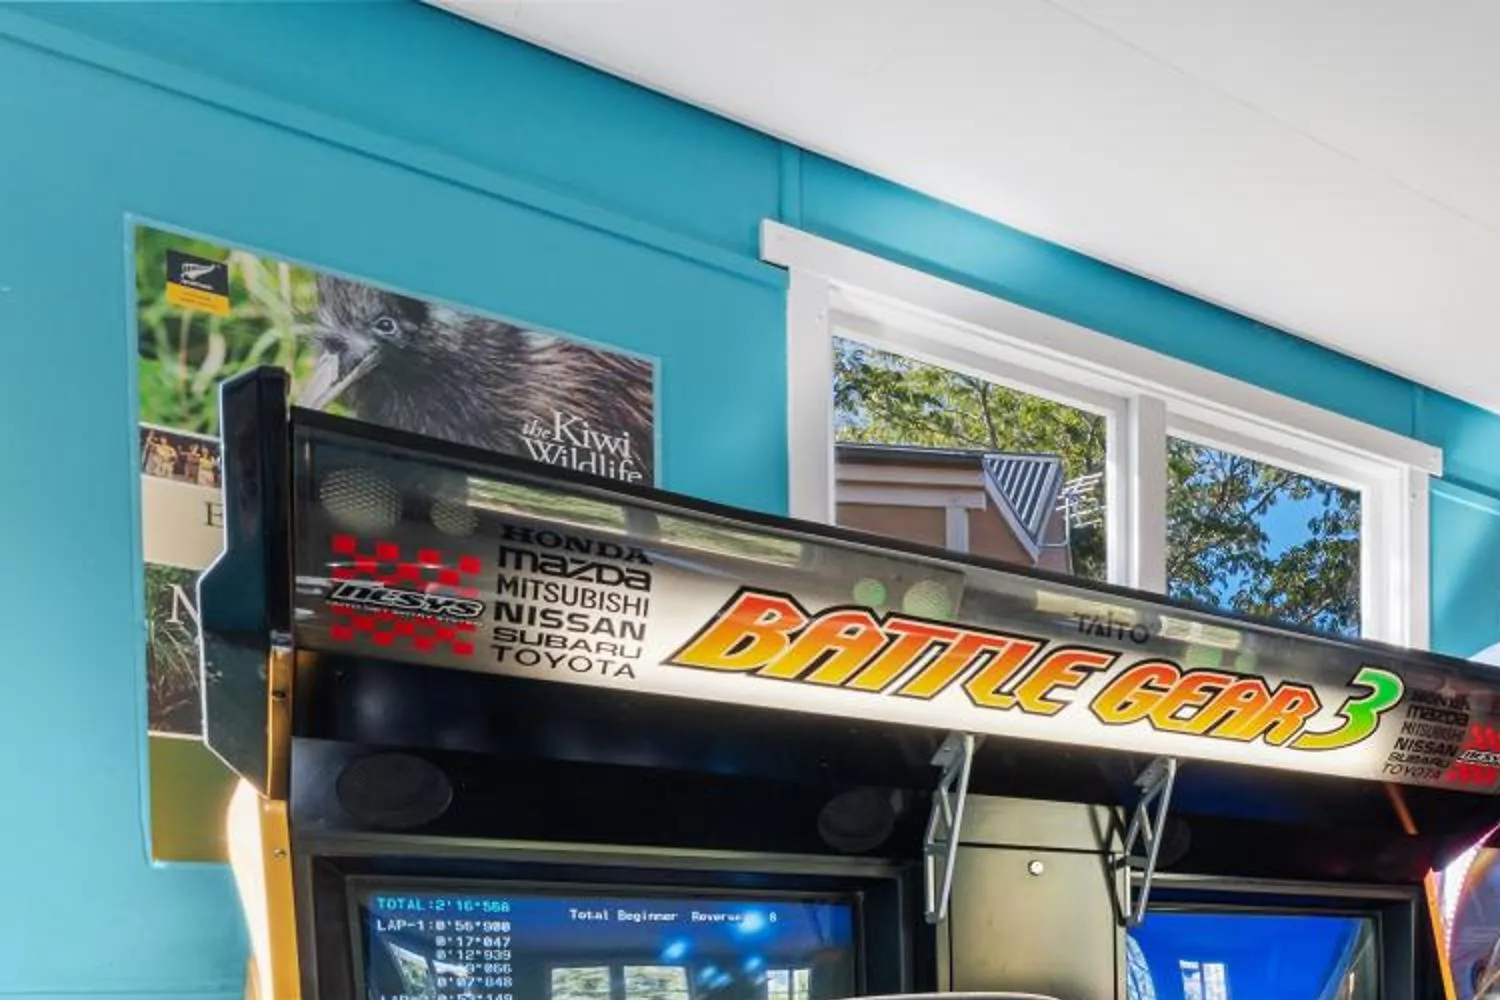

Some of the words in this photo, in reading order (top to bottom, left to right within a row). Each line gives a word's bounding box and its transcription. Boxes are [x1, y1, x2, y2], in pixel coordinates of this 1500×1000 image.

[522, 419, 551, 439] the
[551, 408, 633, 459] Kiwi
[520, 438, 643, 482] Wildlife
[501, 525, 654, 565] HONDA
[497, 573, 649, 618] MITSUBISHI
[494, 602, 646, 641] NISSAN
[1074, 611, 1150, 644] TAITO
[491, 627, 641, 659] SUBARU
[490, 645, 636, 680] TOYOTA
[661, 585, 1122, 716] BATTLE
[1089, 657, 1321, 746] GEAR
[1287, 664, 1406, 751] 3
[1388, 751, 1450, 768] SUBARU
[1394, 737, 1458, 757] NISSAN
[1382, 761, 1441, 779] TOYOTA
[569, 908, 609, 921] Total
[617, 909, 678, 923] Beginner
